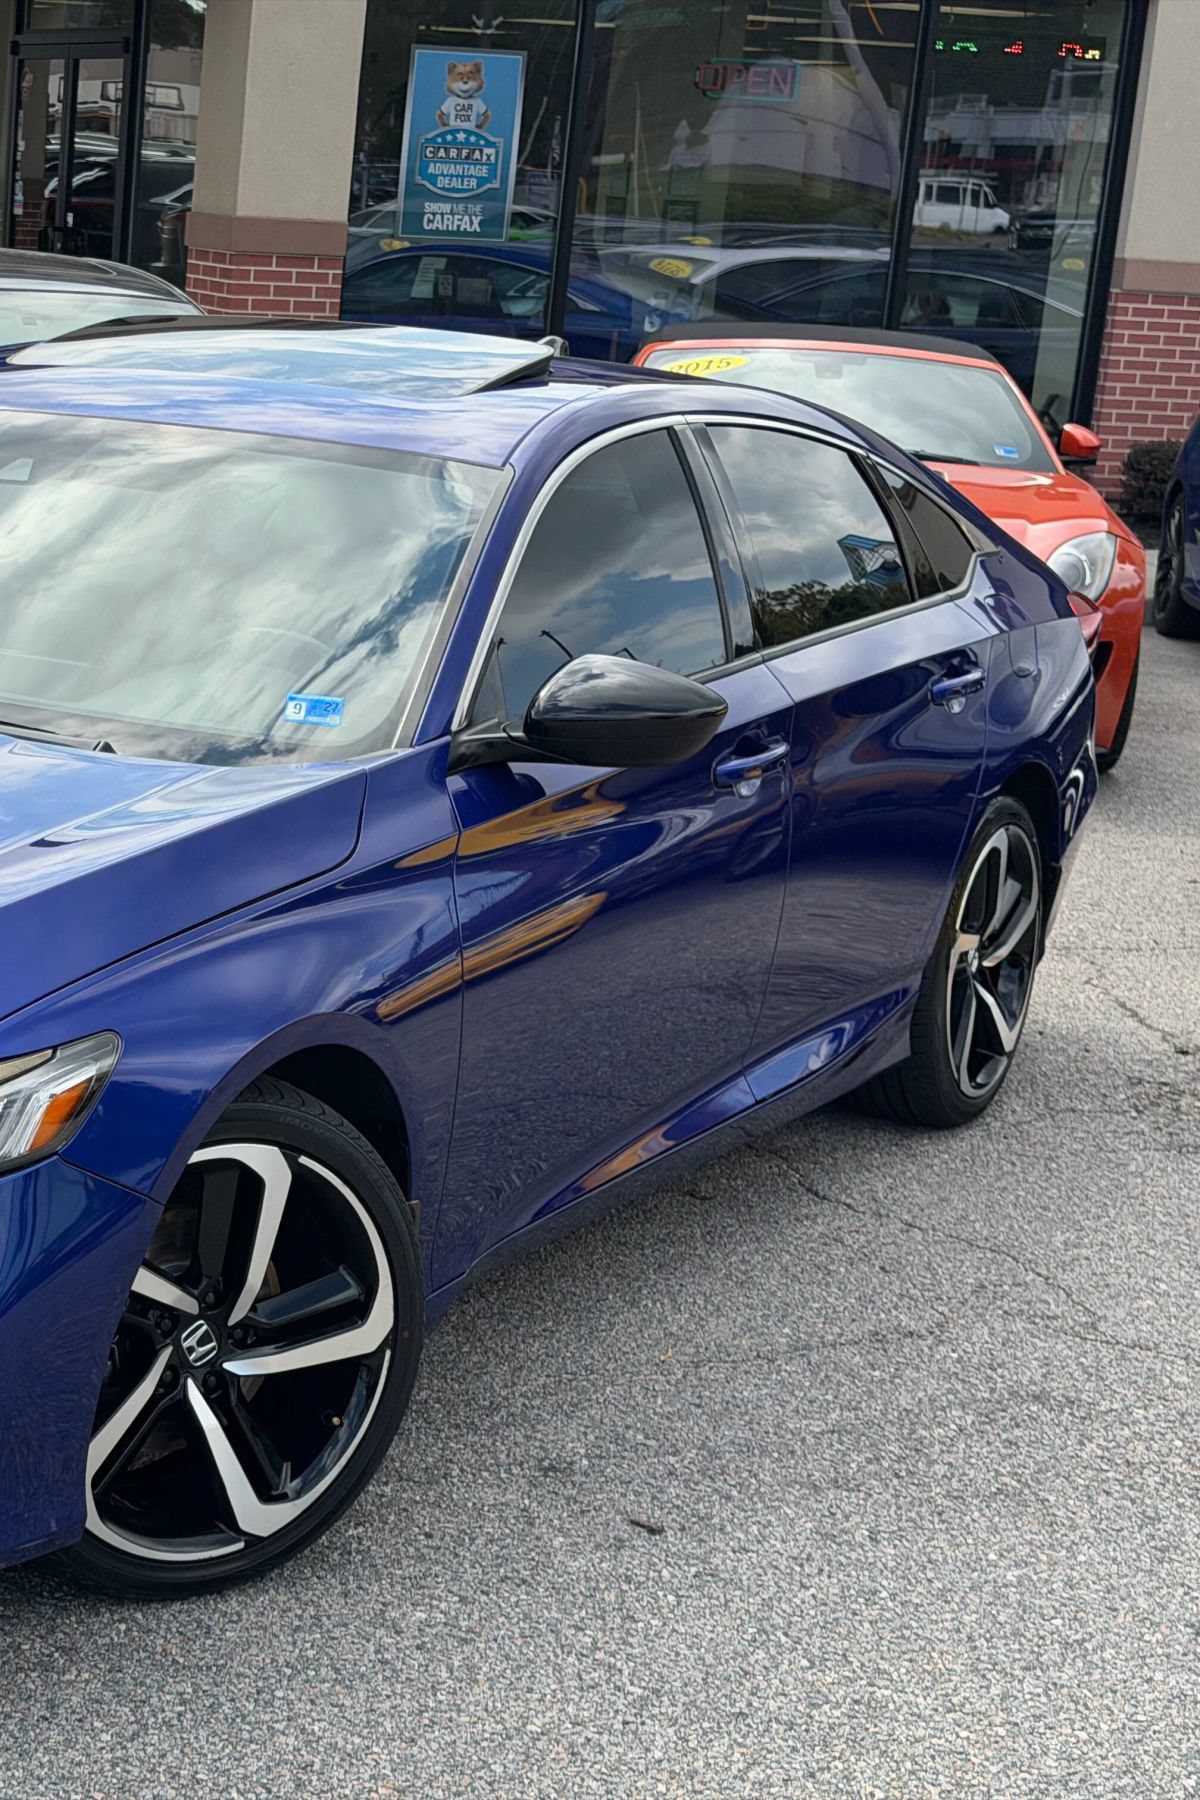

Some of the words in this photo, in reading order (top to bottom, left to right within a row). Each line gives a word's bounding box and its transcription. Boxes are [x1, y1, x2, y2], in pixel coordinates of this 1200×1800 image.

[700, 64, 793, 96] OPEN
[454, 103, 473, 113] CAR
[454, 113, 472, 123] FOX
[425, 146, 495, 163] CARFAX
[428, 163, 489, 177] ADVANTAGE
[437, 177, 477, 189] DEALER
[424, 201, 452, 213] SHOW
[453, 203, 466, 214] ME
[467, 204, 483, 215] THE
[422, 213, 482, 232] CARFAX
[292, 702, 303, 715] 9
[323, 701, 340, 713] 27
